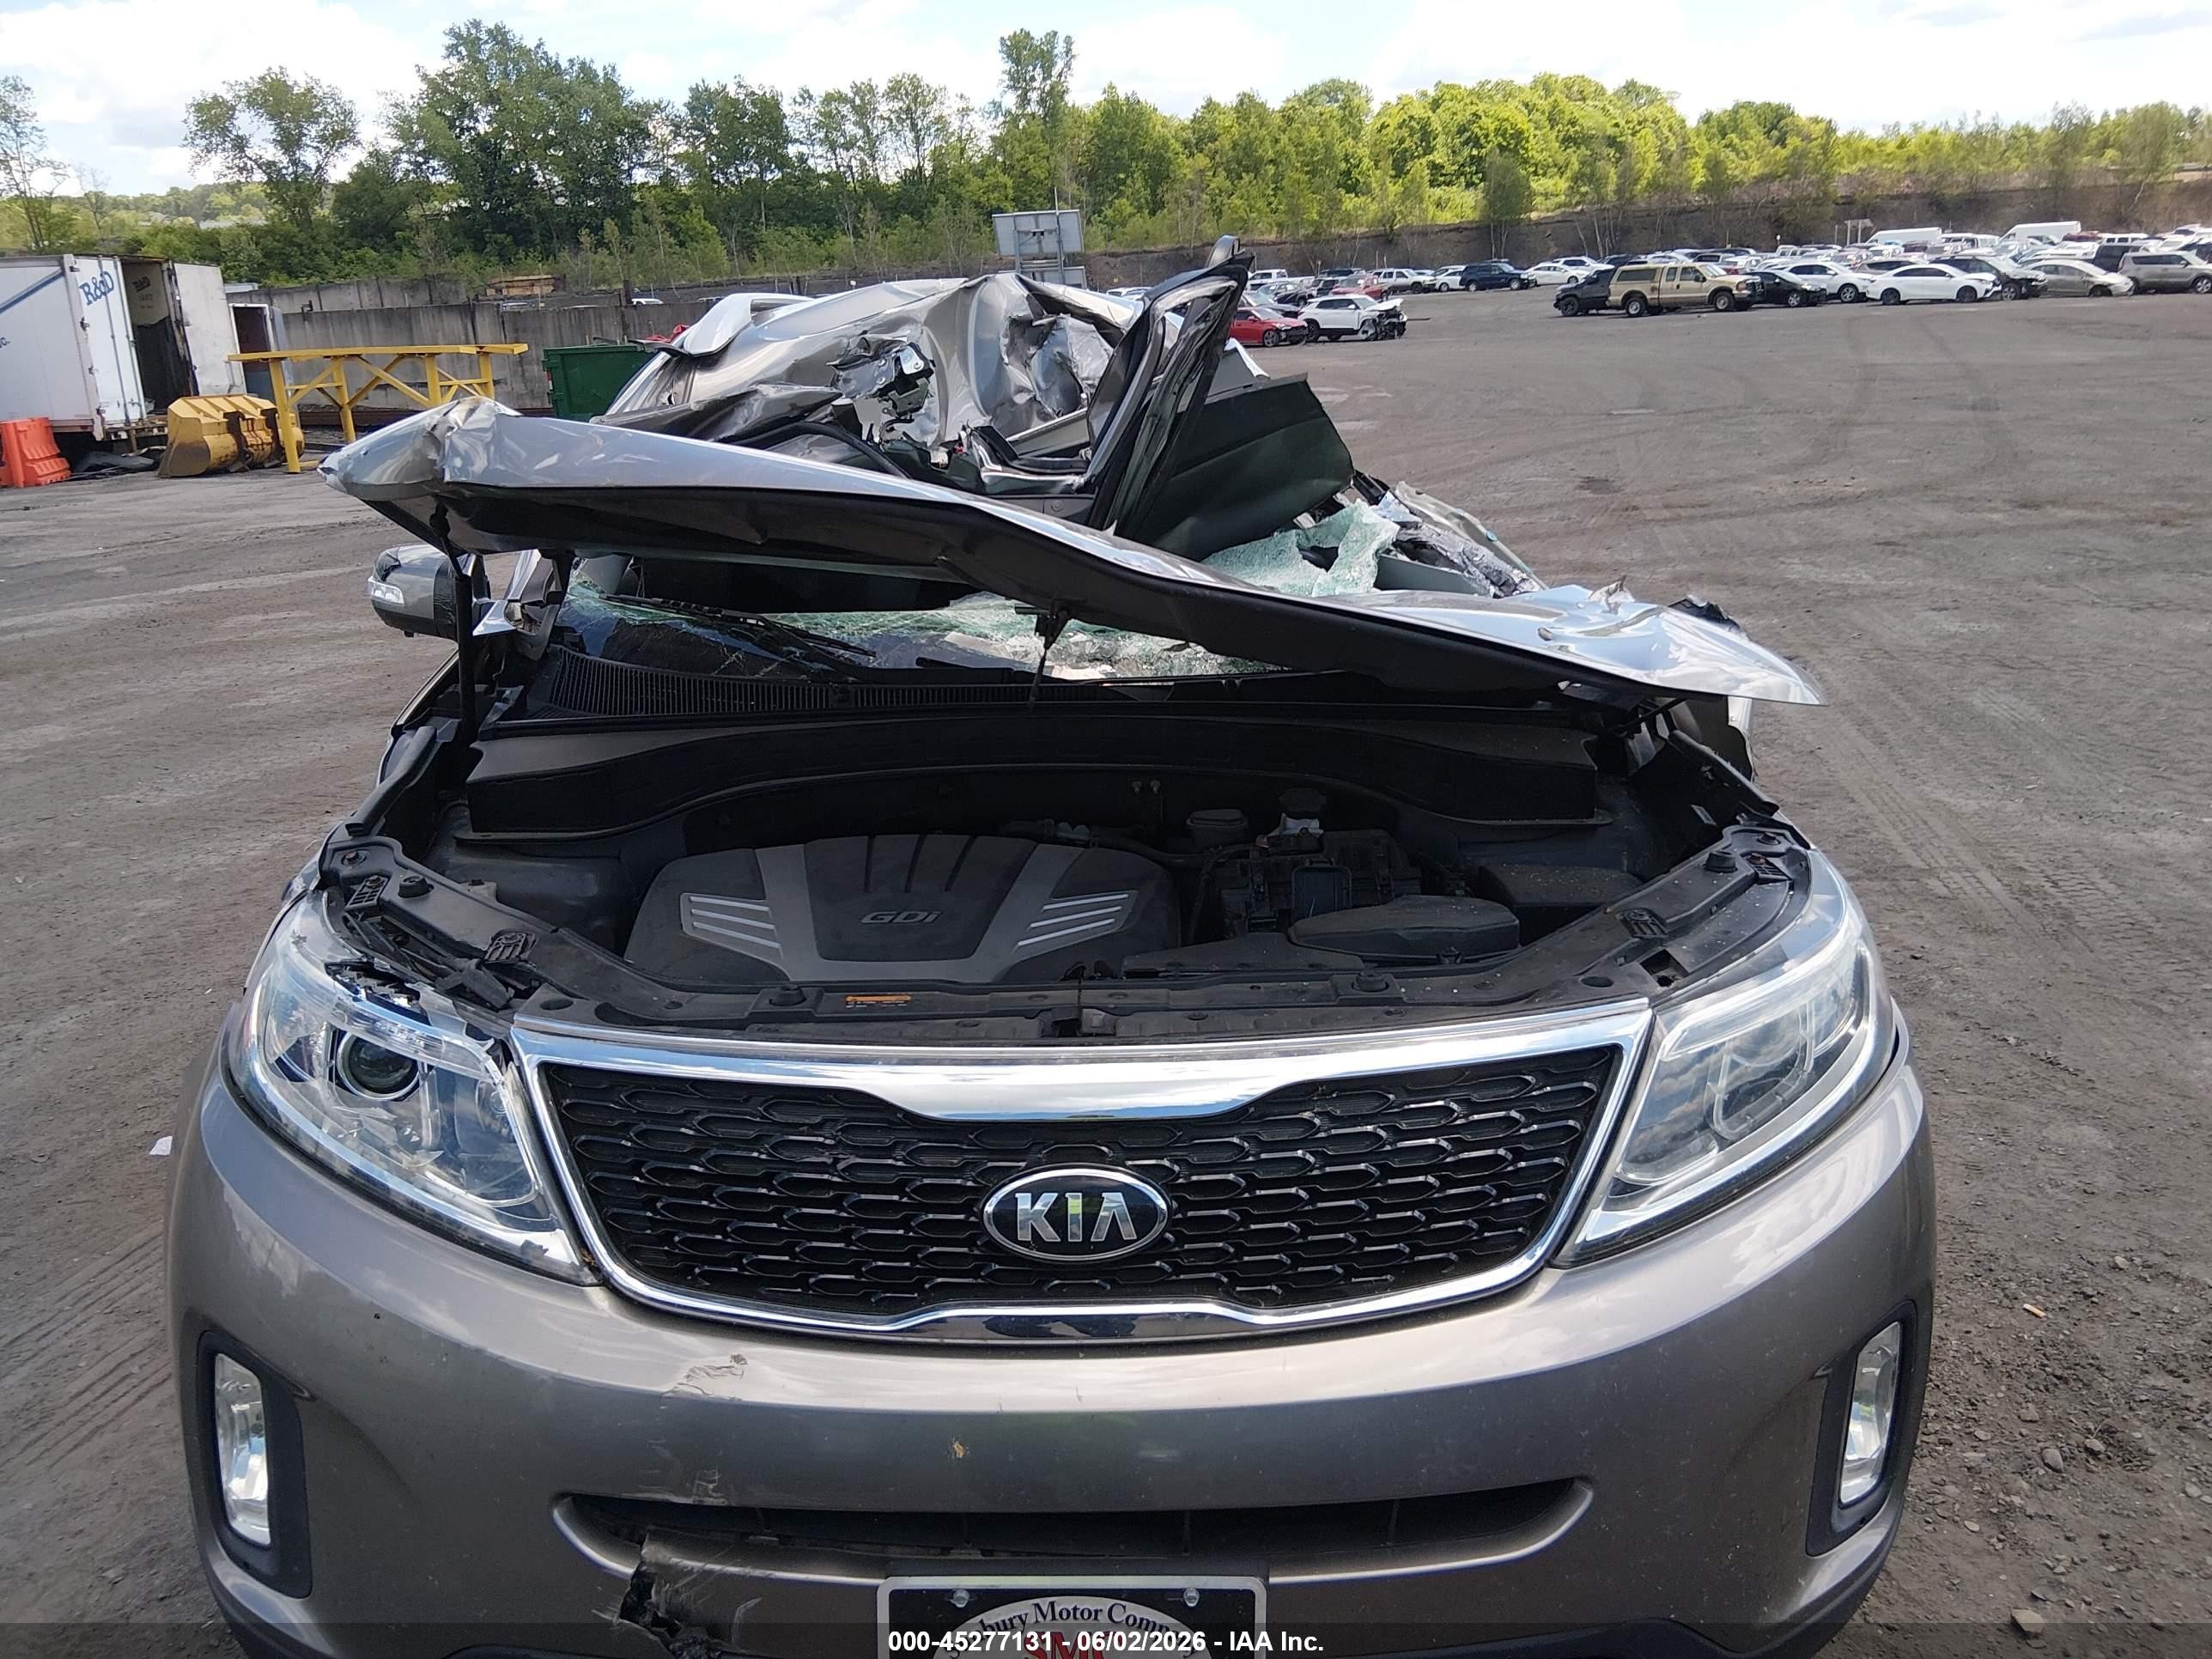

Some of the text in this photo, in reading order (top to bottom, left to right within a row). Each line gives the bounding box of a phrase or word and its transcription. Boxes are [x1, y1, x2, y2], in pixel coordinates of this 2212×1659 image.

[79, 271, 114, 306] R&D
[1015, 1192, 1137, 1243] KIA
[1031, 1601, 1103, 1623] Motor
